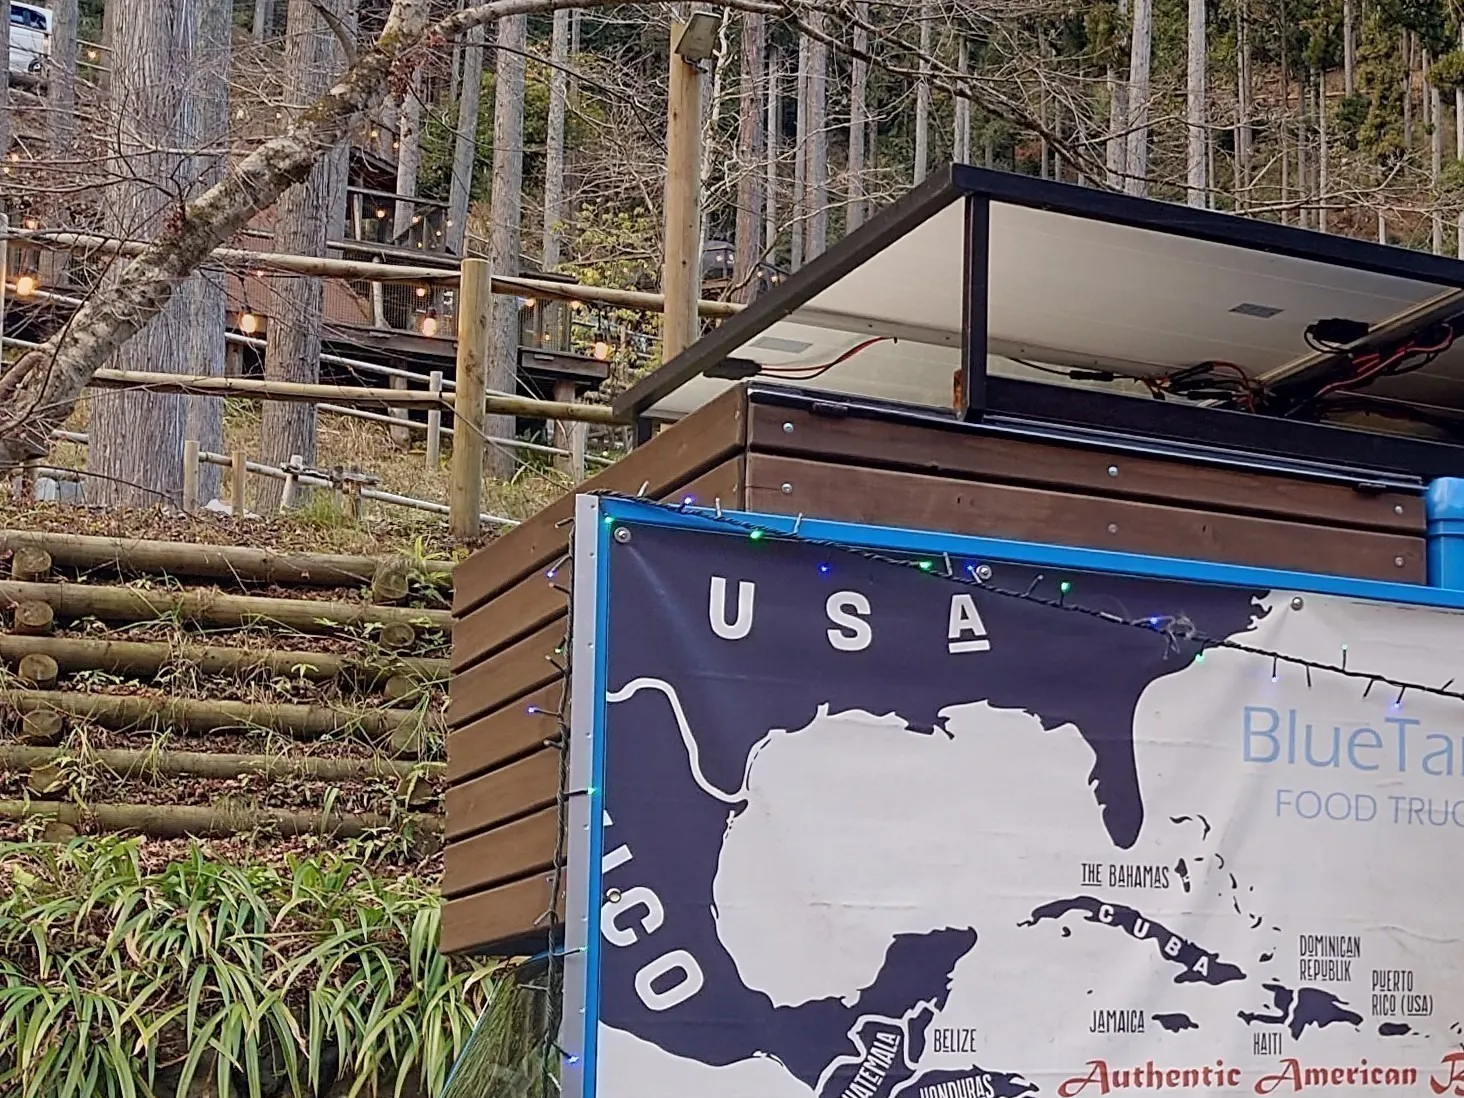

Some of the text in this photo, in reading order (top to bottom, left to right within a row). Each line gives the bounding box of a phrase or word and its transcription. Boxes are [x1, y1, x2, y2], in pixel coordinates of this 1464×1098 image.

[1275, 789, 1377, 823] FOOD
[1081, 863, 1170, 889] THE BAHAMAS
[1099, 904, 1208, 978] CUBA
[1299, 934, 1361, 959] DOMINICAN
[1299, 958, 1352, 982] REPUBLIK
[1371, 969, 1414, 994] PUERTO
[1371, 993, 1434, 1018] RICO (USA)
[1089, 1010, 1146, 1035] JAMAICA
[933, 1029, 977, 1053] BELIZE
[1253, 1032, 1284, 1056] HAITI
[1057, 1059, 1242, 1098] Authentic
[1254, 1061, 1418, 1095] American
